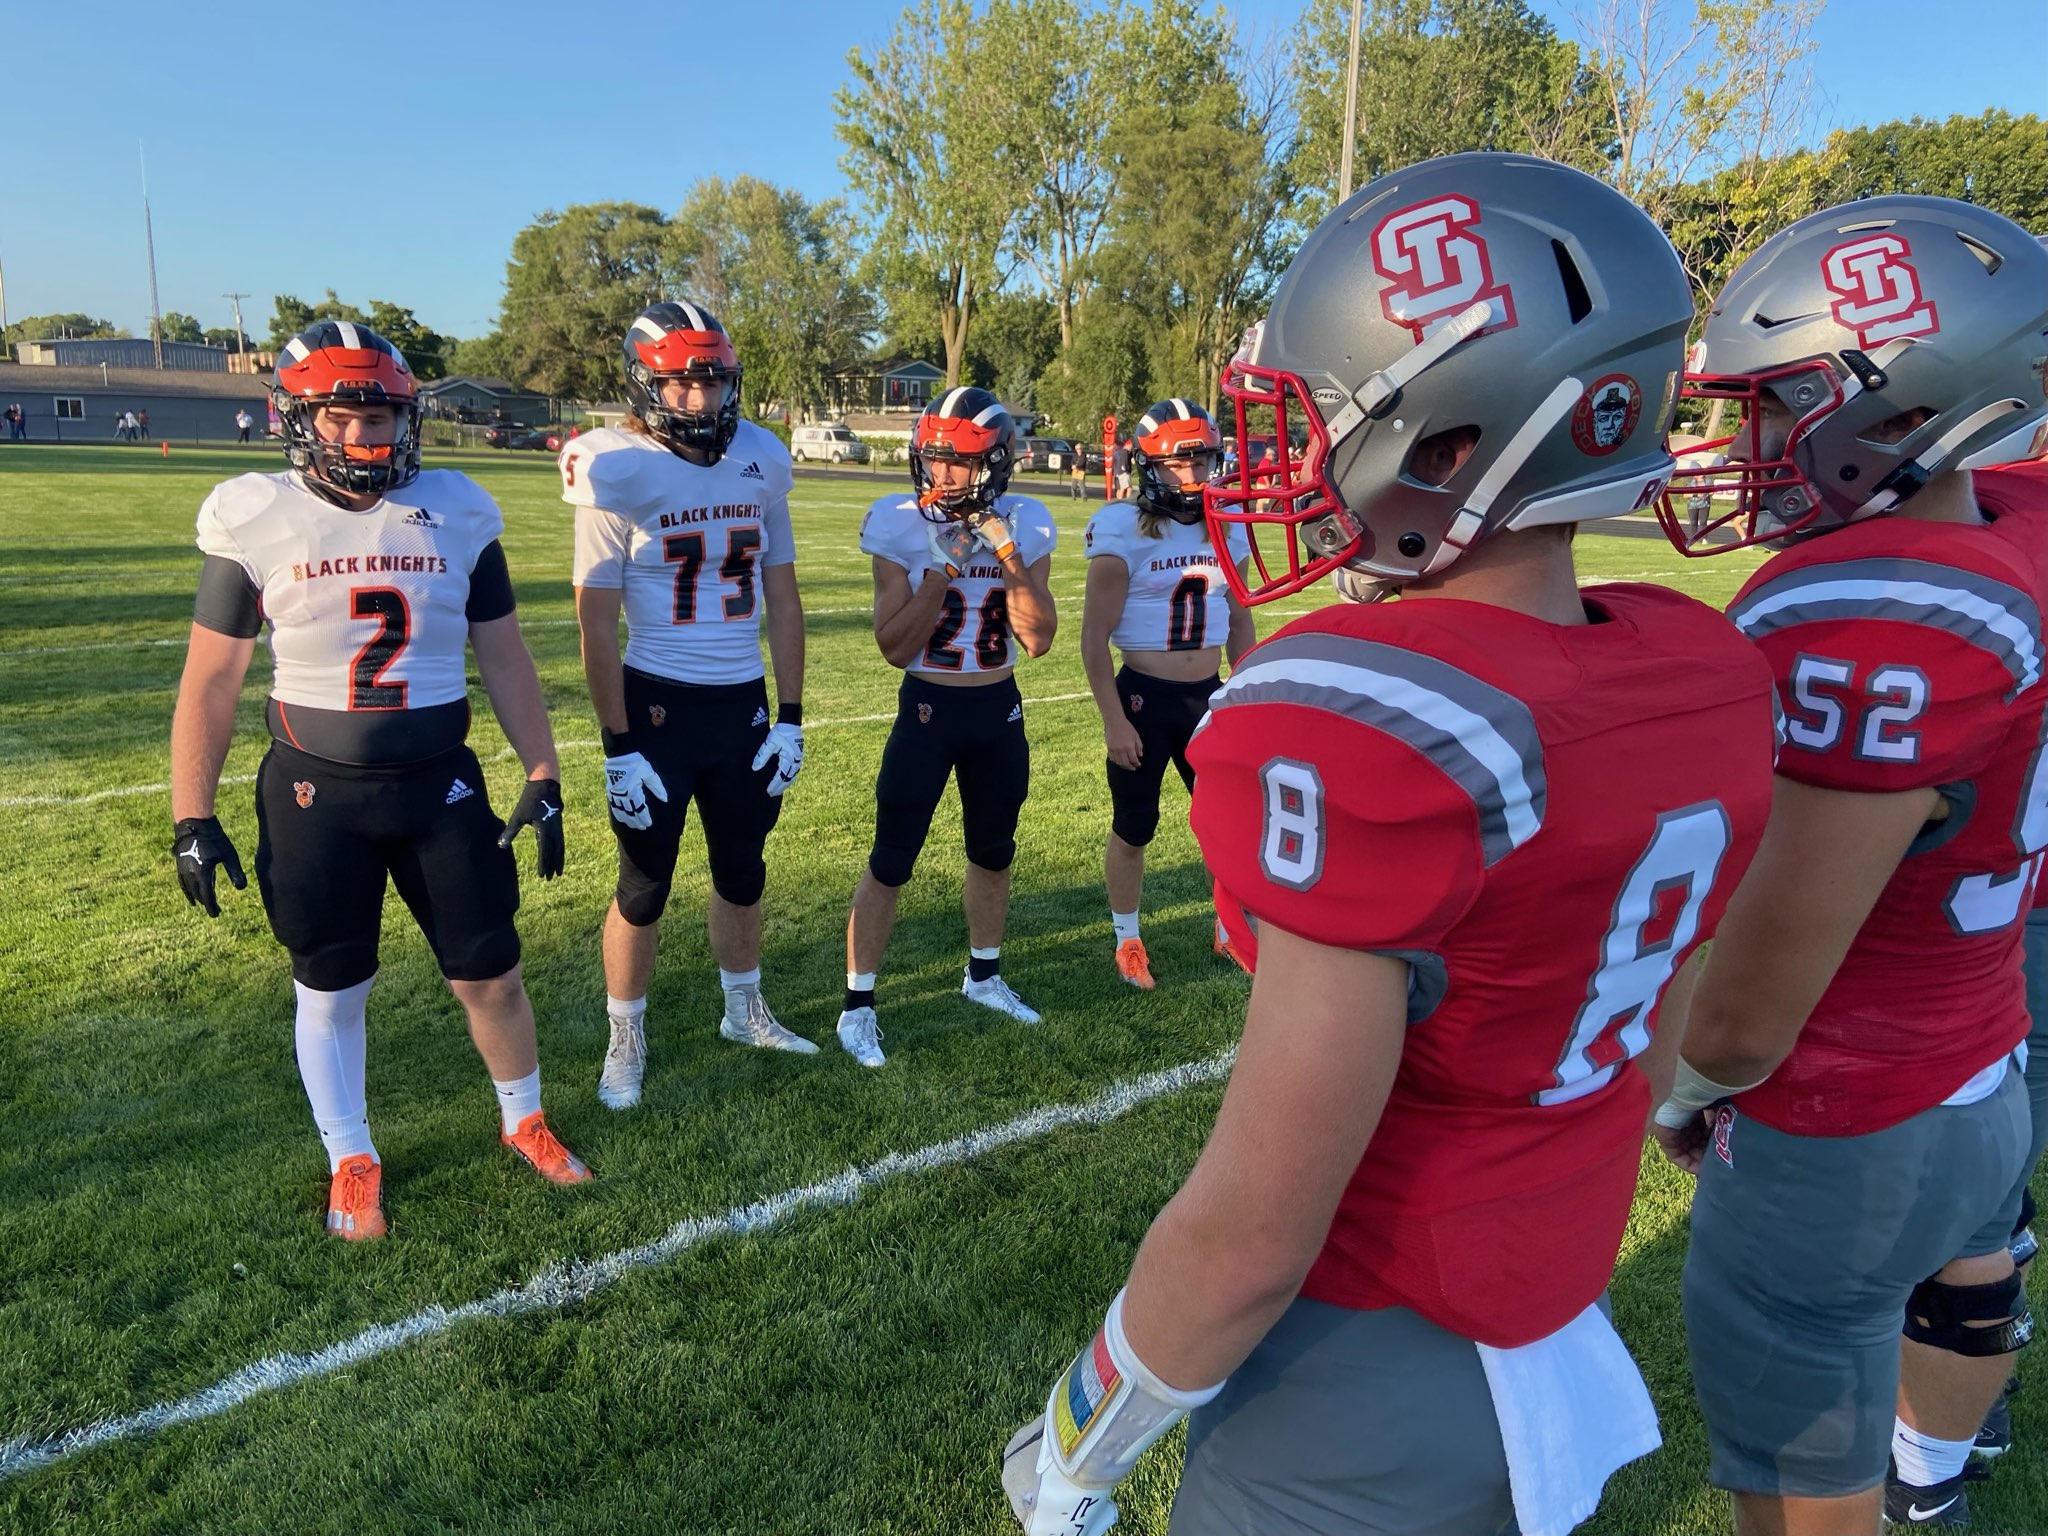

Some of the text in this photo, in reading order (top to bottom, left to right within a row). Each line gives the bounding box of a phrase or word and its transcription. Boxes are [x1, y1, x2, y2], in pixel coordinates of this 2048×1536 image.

[1312, 391, 1342, 400] SPEED
[739, 471, 764, 481] adidas
[401, 518, 438, 529] adidas
[659, 503, 761, 528] BLACK KNIGHTS
[292, 555, 447, 582] BLACK KNIGHTS
[662, 525, 761, 625] 75
[1150, 555, 1219, 572] BLACK KNIGH
[922, 586, 1008, 671] 28
[1166, 574, 1209, 651] 0
[347, 586, 412, 711] 2
[1786, 652, 1931, 764] 52
[445, 787, 475, 804] adidas
[1258, 756, 1326, 893] 8
[1529, 799, 1733, 1106] 8
